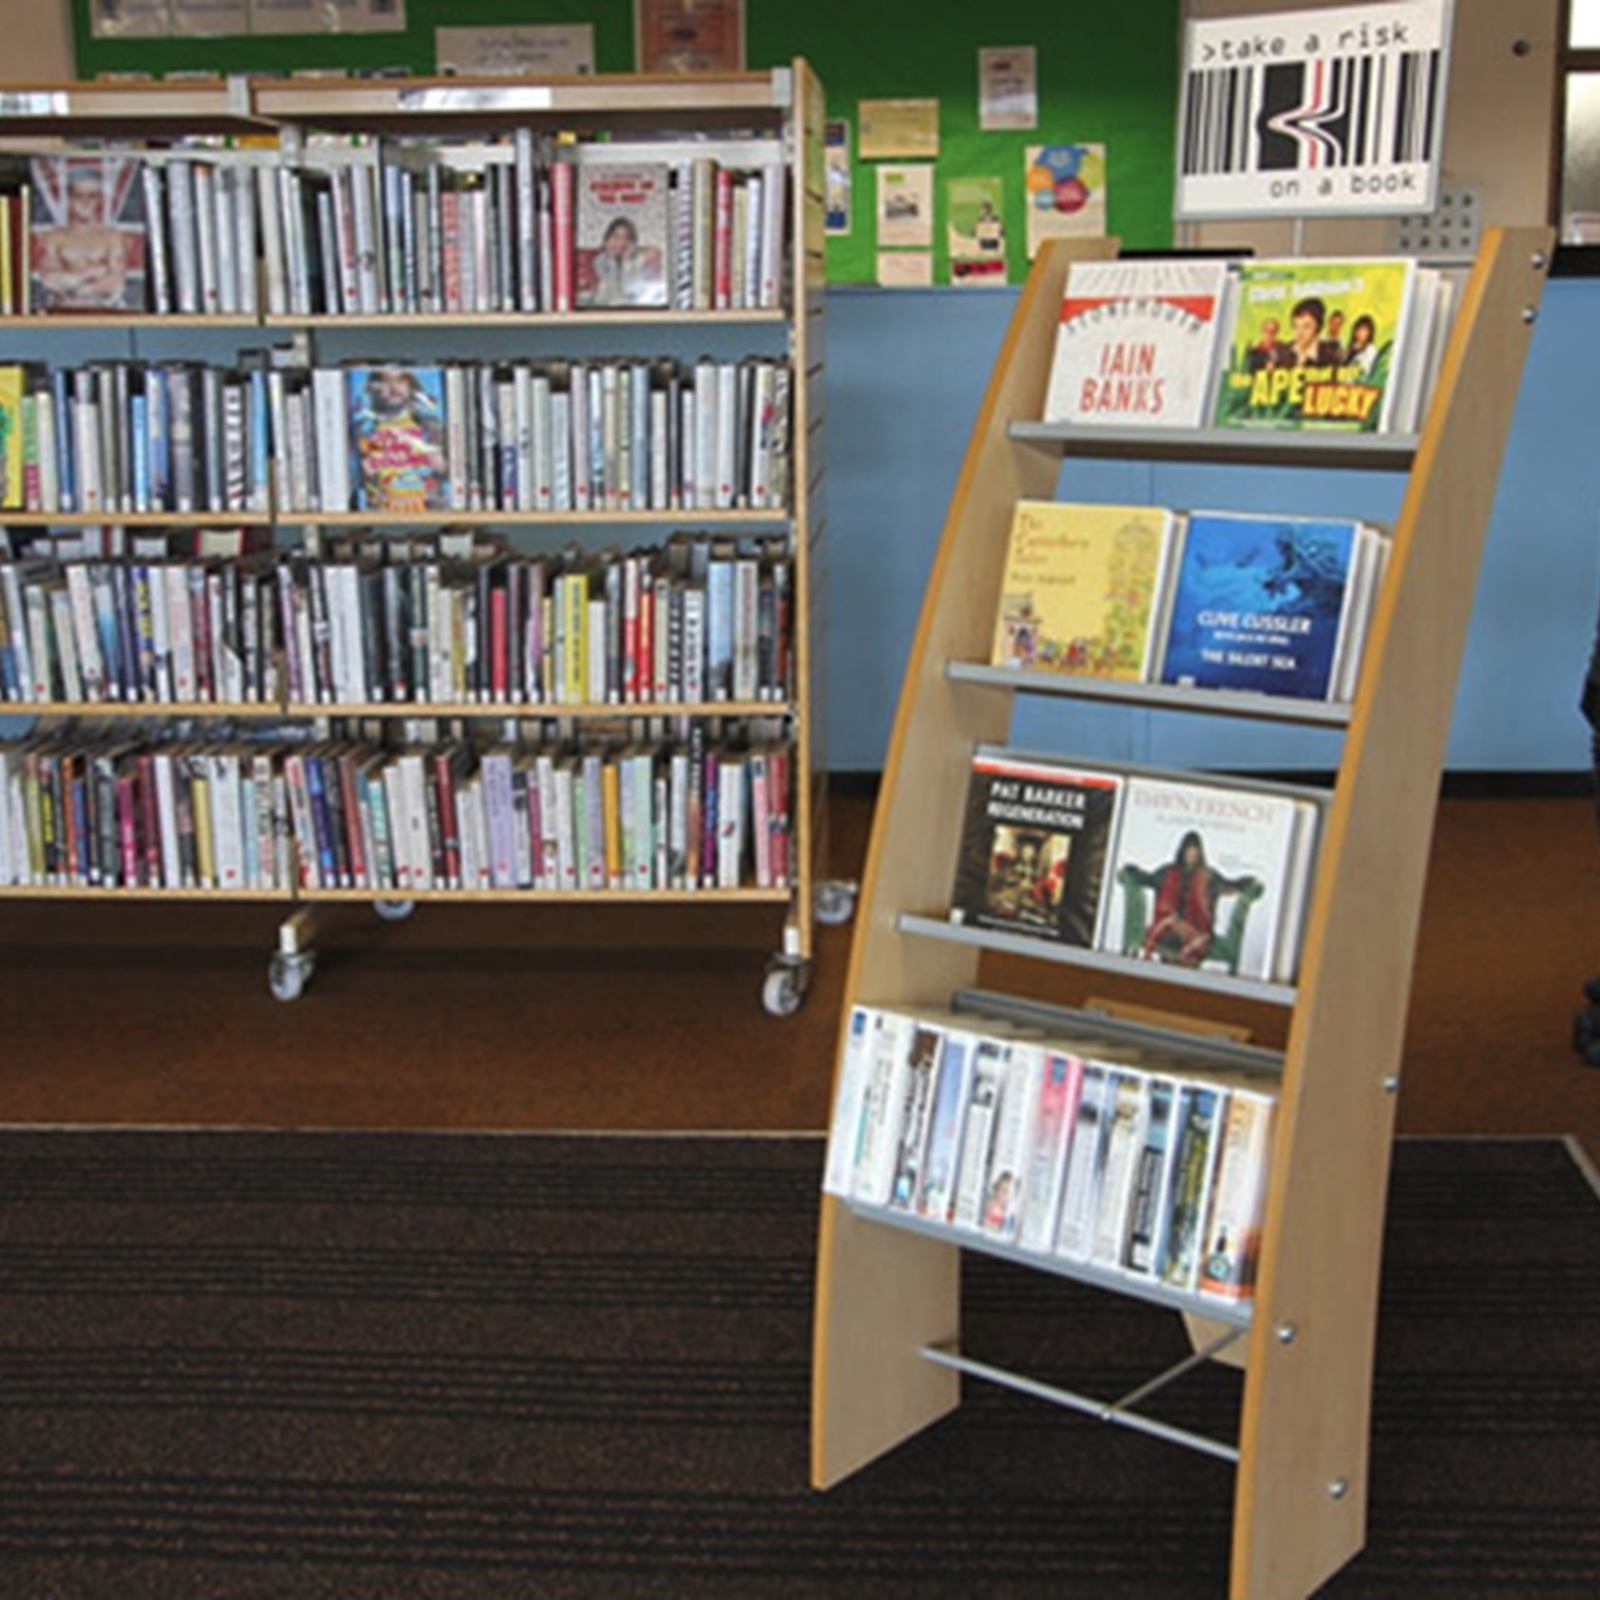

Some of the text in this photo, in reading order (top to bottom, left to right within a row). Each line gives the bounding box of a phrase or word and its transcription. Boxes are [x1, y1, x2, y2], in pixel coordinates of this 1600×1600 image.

[1304, 34, 1320, 53] a
[1339, 20, 1409, 49] risk
[1269, 170, 1415, 198] on a book
[1100, 342, 1156, 376] IAIN
[1079, 377, 1165, 414] BANKS
[1250, 366, 1306, 407] APE
[1303, 384, 1380, 421] LUCKY
[1197, 609, 1312, 635] CLIVE CUSSLER
[1200, 649, 1297, 670] THE SILENT SEA
[990, 780, 1086, 810] PAT BARKER
[986, 801, 1086, 830] REGENERATION
